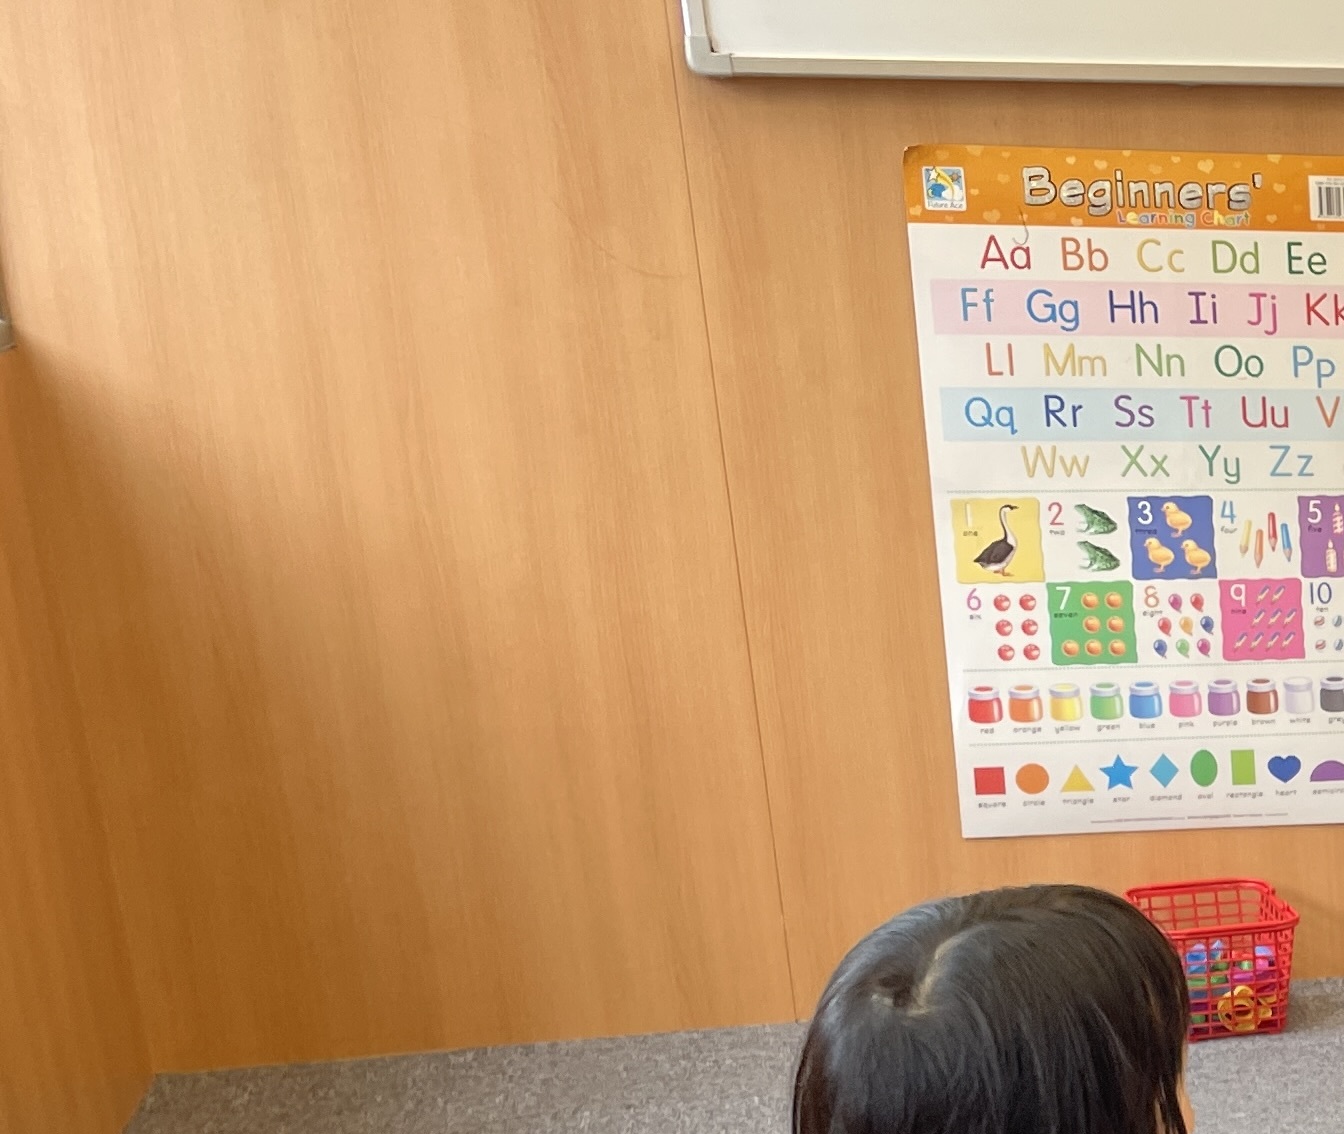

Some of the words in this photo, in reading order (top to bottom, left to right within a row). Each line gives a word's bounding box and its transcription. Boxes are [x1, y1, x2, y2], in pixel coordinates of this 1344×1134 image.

[1021, 165, 1263, 217] Beginners'
[1116, 210, 1197, 229] Learning
[1201, 209, 1250, 227] Chart
[980, 234, 1032, 270] Aa
[1060, 237, 1109, 272] Bb
[1136, 238, 1185, 273] Cc
[1211, 240, 1260, 274] Dd
[1286, 241, 1327, 275] Ee
[961, 288, 994, 322] Ff
[1026, 289, 1080, 331] Gg
[1108, 290, 1159, 324] Hh
[1189, 292, 1218, 324] Ii
[1247, 292, 1278, 335] Jj
[985, 342, 1014, 376] Ll
[1043, 343, 1107, 377] Mm
[1135, 343, 1186, 378] Nn
[1214, 344, 1264, 378] Oo
[1292, 346, 1336, 388] Pp
[964, 397, 1018, 435] Qq
[1045, 396, 1083, 428] Rr
[1114, 396, 1154, 428] Ss
[1179, 396, 1213, 428] Tt
[1240, 396, 1289, 428] Uu
[1021, 445, 1090, 478] Ww
[1120, 445, 1170, 478] Xx
[1198, 445, 1240, 484] Yy
[1269, 446, 1315, 477] Zz
[966, 503, 972, 529] 1
[1048, 502, 1064, 526] 2
[1137, 500, 1153, 525] 3
[1220, 500, 1236, 524] 4
[1307, 500, 1322, 524] 5
[966, 588, 982, 611] 6
[1055, 586, 1071, 610] 7
[1144, 586, 1160, 608] 8
[1230, 584, 1246, 608] 9
[1309, 582, 1332, 604] 10
[980, 726, 994, 734] red
[1013, 726, 1042, 734] orange
[1054, 725, 1080, 734] yellow
[1096, 724, 1120, 732] green
[1139, 722, 1156, 730] blue
[1178, 720, 1195, 728] pink
[1275, 788, 1298, 796] heart
